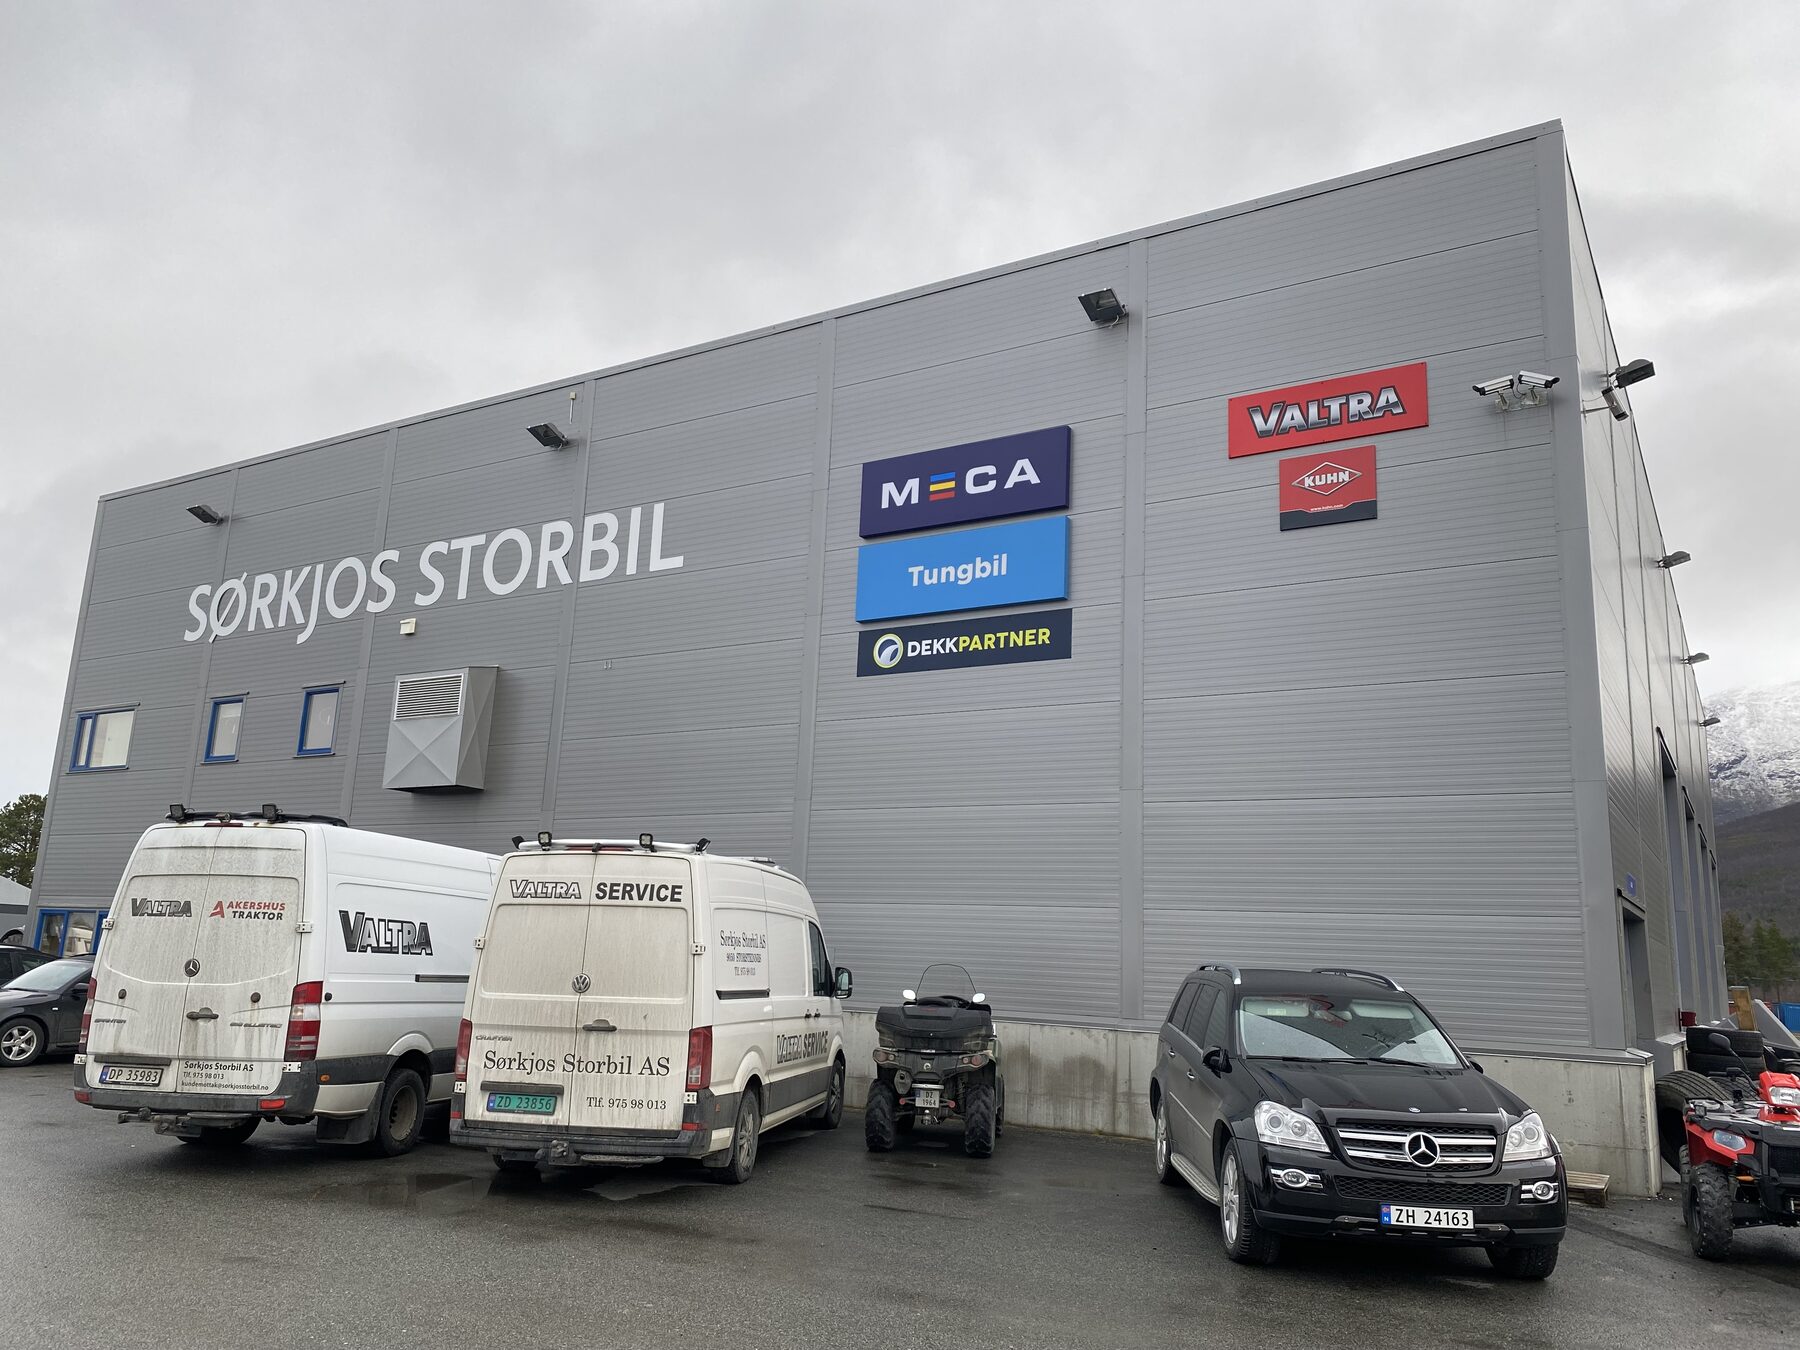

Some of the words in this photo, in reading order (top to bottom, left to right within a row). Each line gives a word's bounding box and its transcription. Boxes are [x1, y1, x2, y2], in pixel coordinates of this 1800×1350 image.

[1247, 385, 1407, 438] VALTRA
[881, 458, 1041, 509] MECA
[1304, 471, 1350, 488] KUHN
[183, 549, 399, 645] SØRKJOS
[414, 502, 684, 607] STORBIL
[908, 553, 1008, 587] Tungbil
[907, 627, 1051, 657] DEKKPARTNER
[510, 879, 582, 899] VALTRA
[595, 882, 683, 902] SERVICE
[131, 898, 192, 917] VALTRA
[227, 901, 286, 911] AKERSHUS
[232, 911, 283, 921] TRAKTOR
[338, 910, 433, 956] VALTRA
[776, 1034, 802, 1064] VALTRA
[803, 1030, 829, 1059] SERVICE
[214, 1062, 241, 1071] Storbil
[243, 1064, 254, 1072] AS
[483, 1050, 556, 1075] Sørkjos
[562, 1053, 632, 1075] Storbil
[638, 1056, 671, 1077] AS
[108, 1069, 123, 1080] DP
[126, 1070, 159, 1082] 35983
[497, 1096, 511, 1108] ZD
[516, 1097, 552, 1110] 23856
[586, 1096, 605, 1108] Tlf.
[608, 1098, 628, 1109] 975
[630, 1099, 644, 1109] 98
[646, 1099, 667, 1110] 013
[1395, 1208, 1416, 1224] ZH
[1423, 1210, 1469, 1226] 24163
